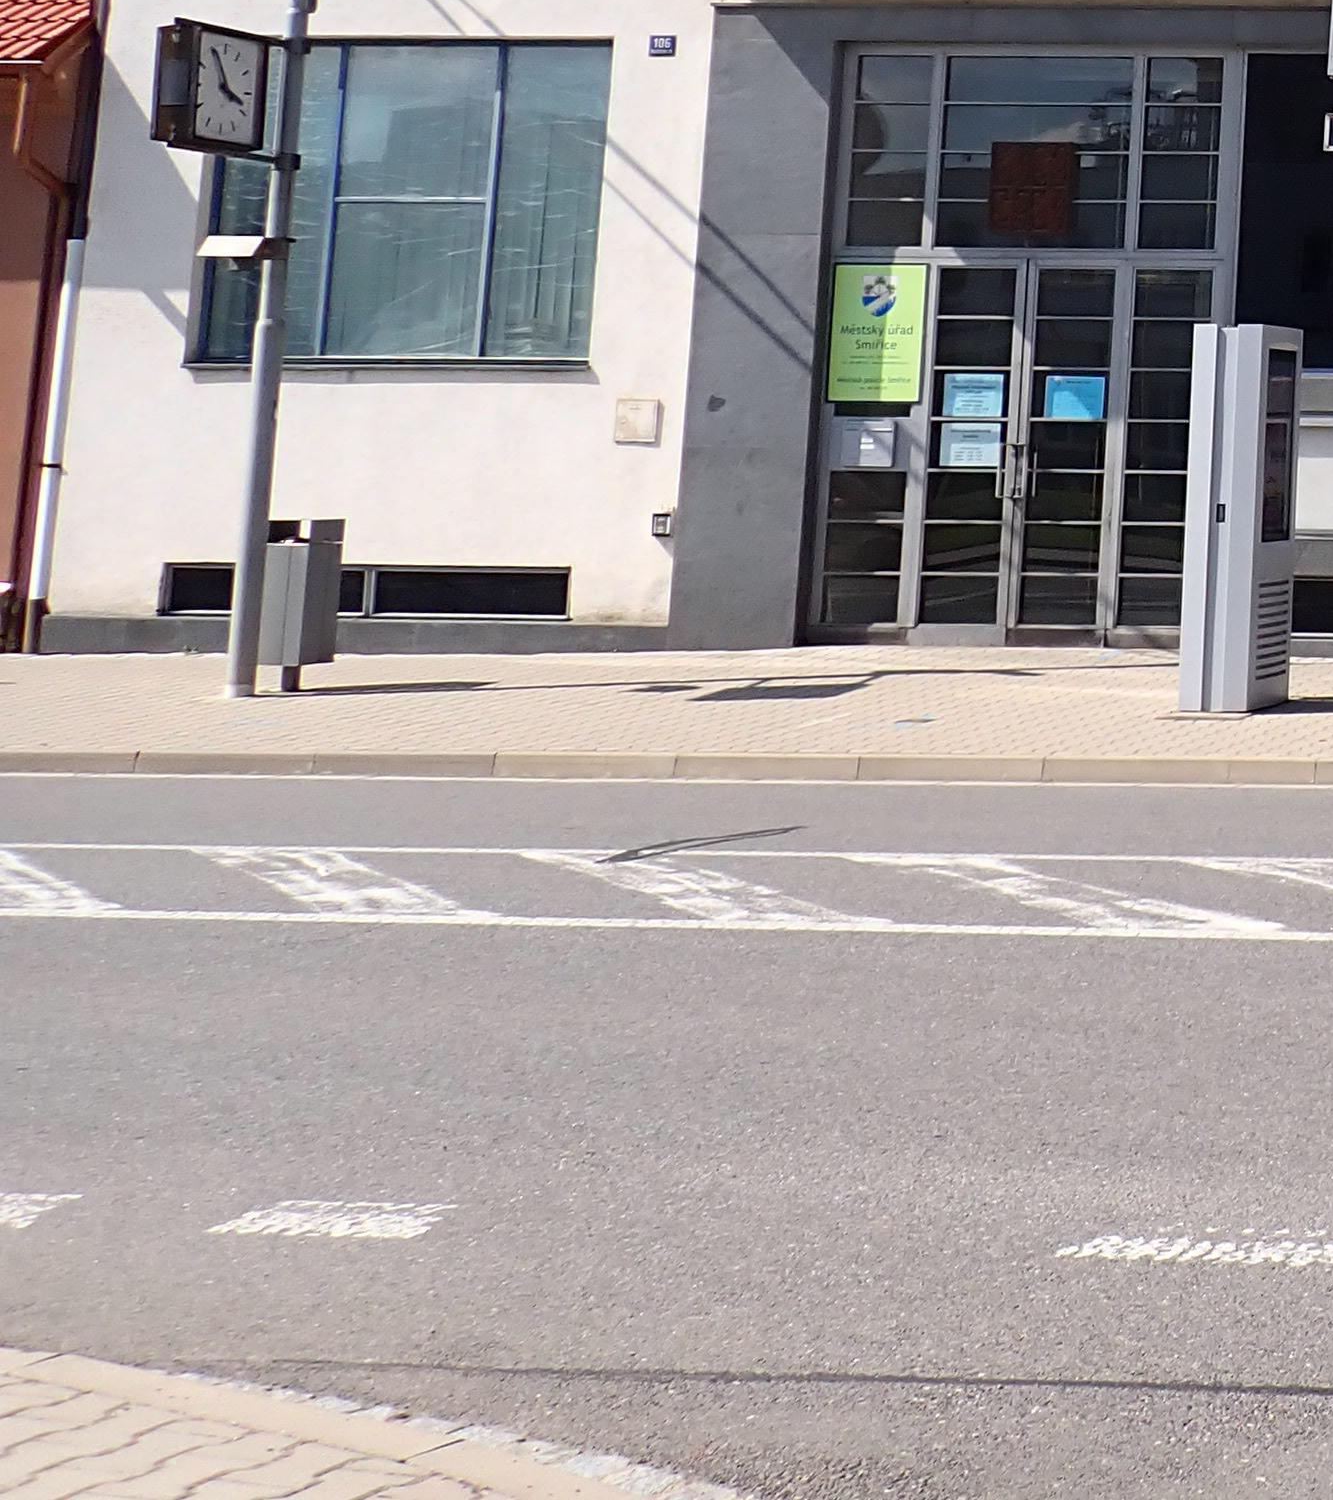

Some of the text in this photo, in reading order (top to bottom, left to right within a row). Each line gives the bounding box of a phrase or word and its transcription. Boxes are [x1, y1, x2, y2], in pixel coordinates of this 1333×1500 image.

[654, 37, 672, 48] 106
[840, 323, 914, 337] Městský úřad
[855, 338, 898, 350] Smiřice
